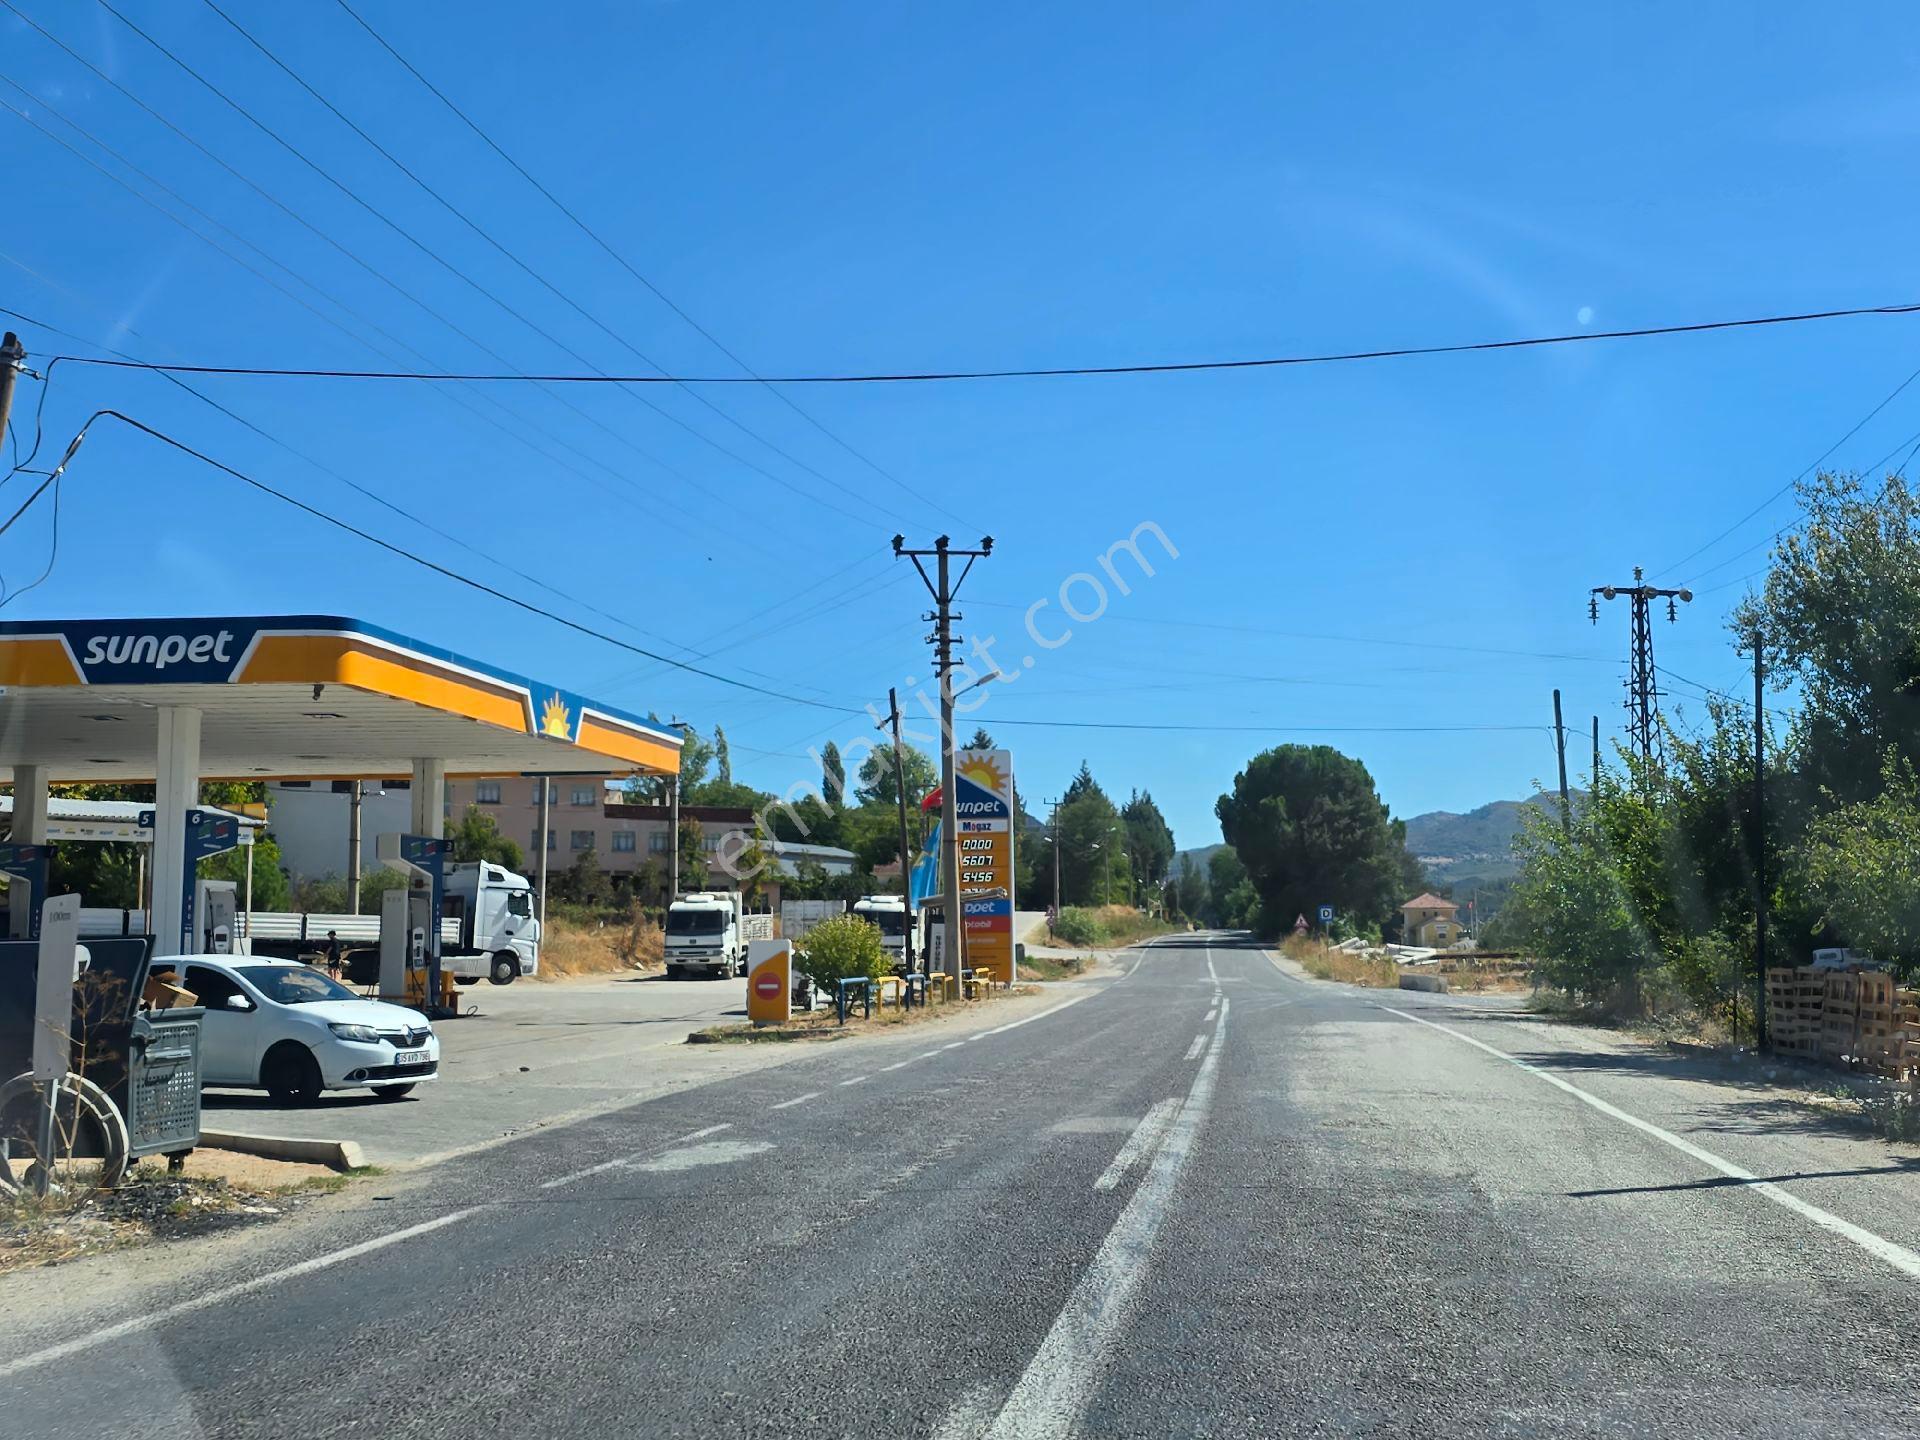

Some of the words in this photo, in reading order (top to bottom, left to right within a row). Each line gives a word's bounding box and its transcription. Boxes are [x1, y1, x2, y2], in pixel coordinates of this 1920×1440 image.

[83, 630, 234, 669] sunpet
[956, 800, 1000, 814] unpet
[141, 813, 150, 825] 5
[191, 813, 201, 824] 6
[962, 821, 991, 832] Mogaz
[1322, 909, 1330, 918] D
